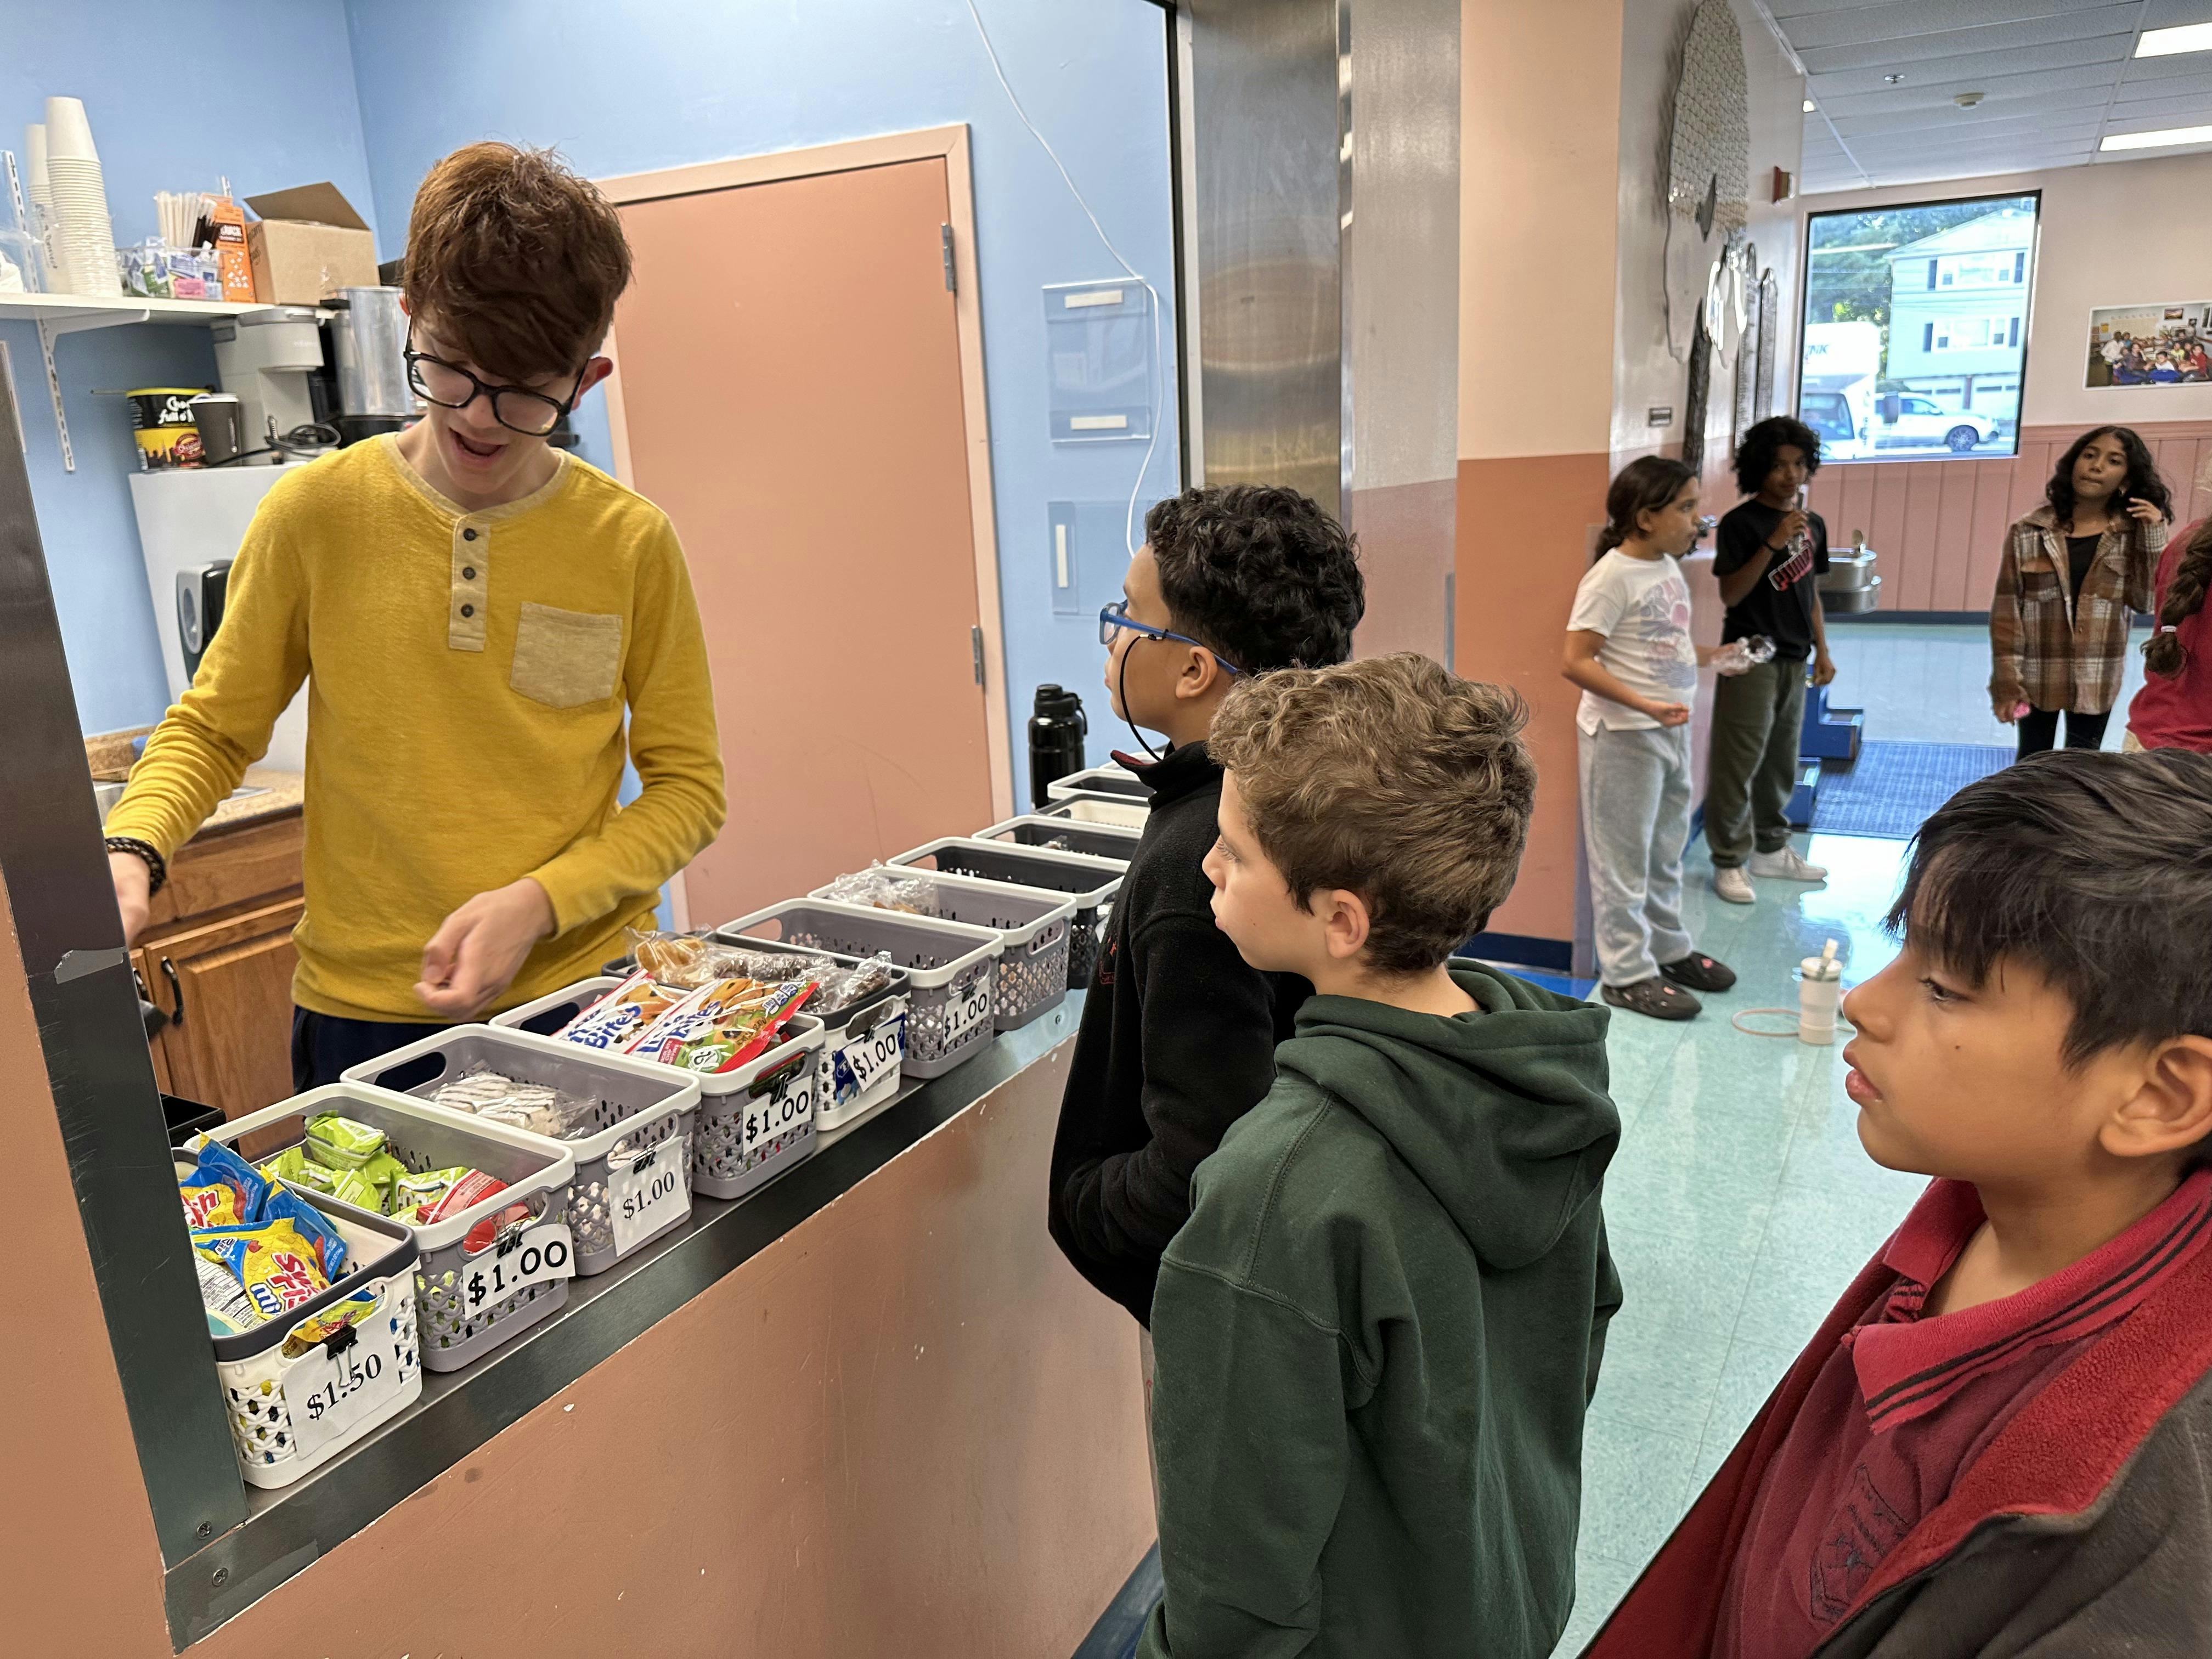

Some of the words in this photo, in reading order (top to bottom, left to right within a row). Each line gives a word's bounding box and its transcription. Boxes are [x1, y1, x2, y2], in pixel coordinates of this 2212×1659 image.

[584, 1005, 641, 1048] Bites
[945, 993, 987, 1040] $1.00
[853, 1034, 896, 1082] $1.00
[746, 1091, 809, 1144] $1.00
[623, 1171, 675, 1221] $1.00
[468, 1240, 567, 1307] $1.00
[307, 1354, 382, 1421] $1.50
